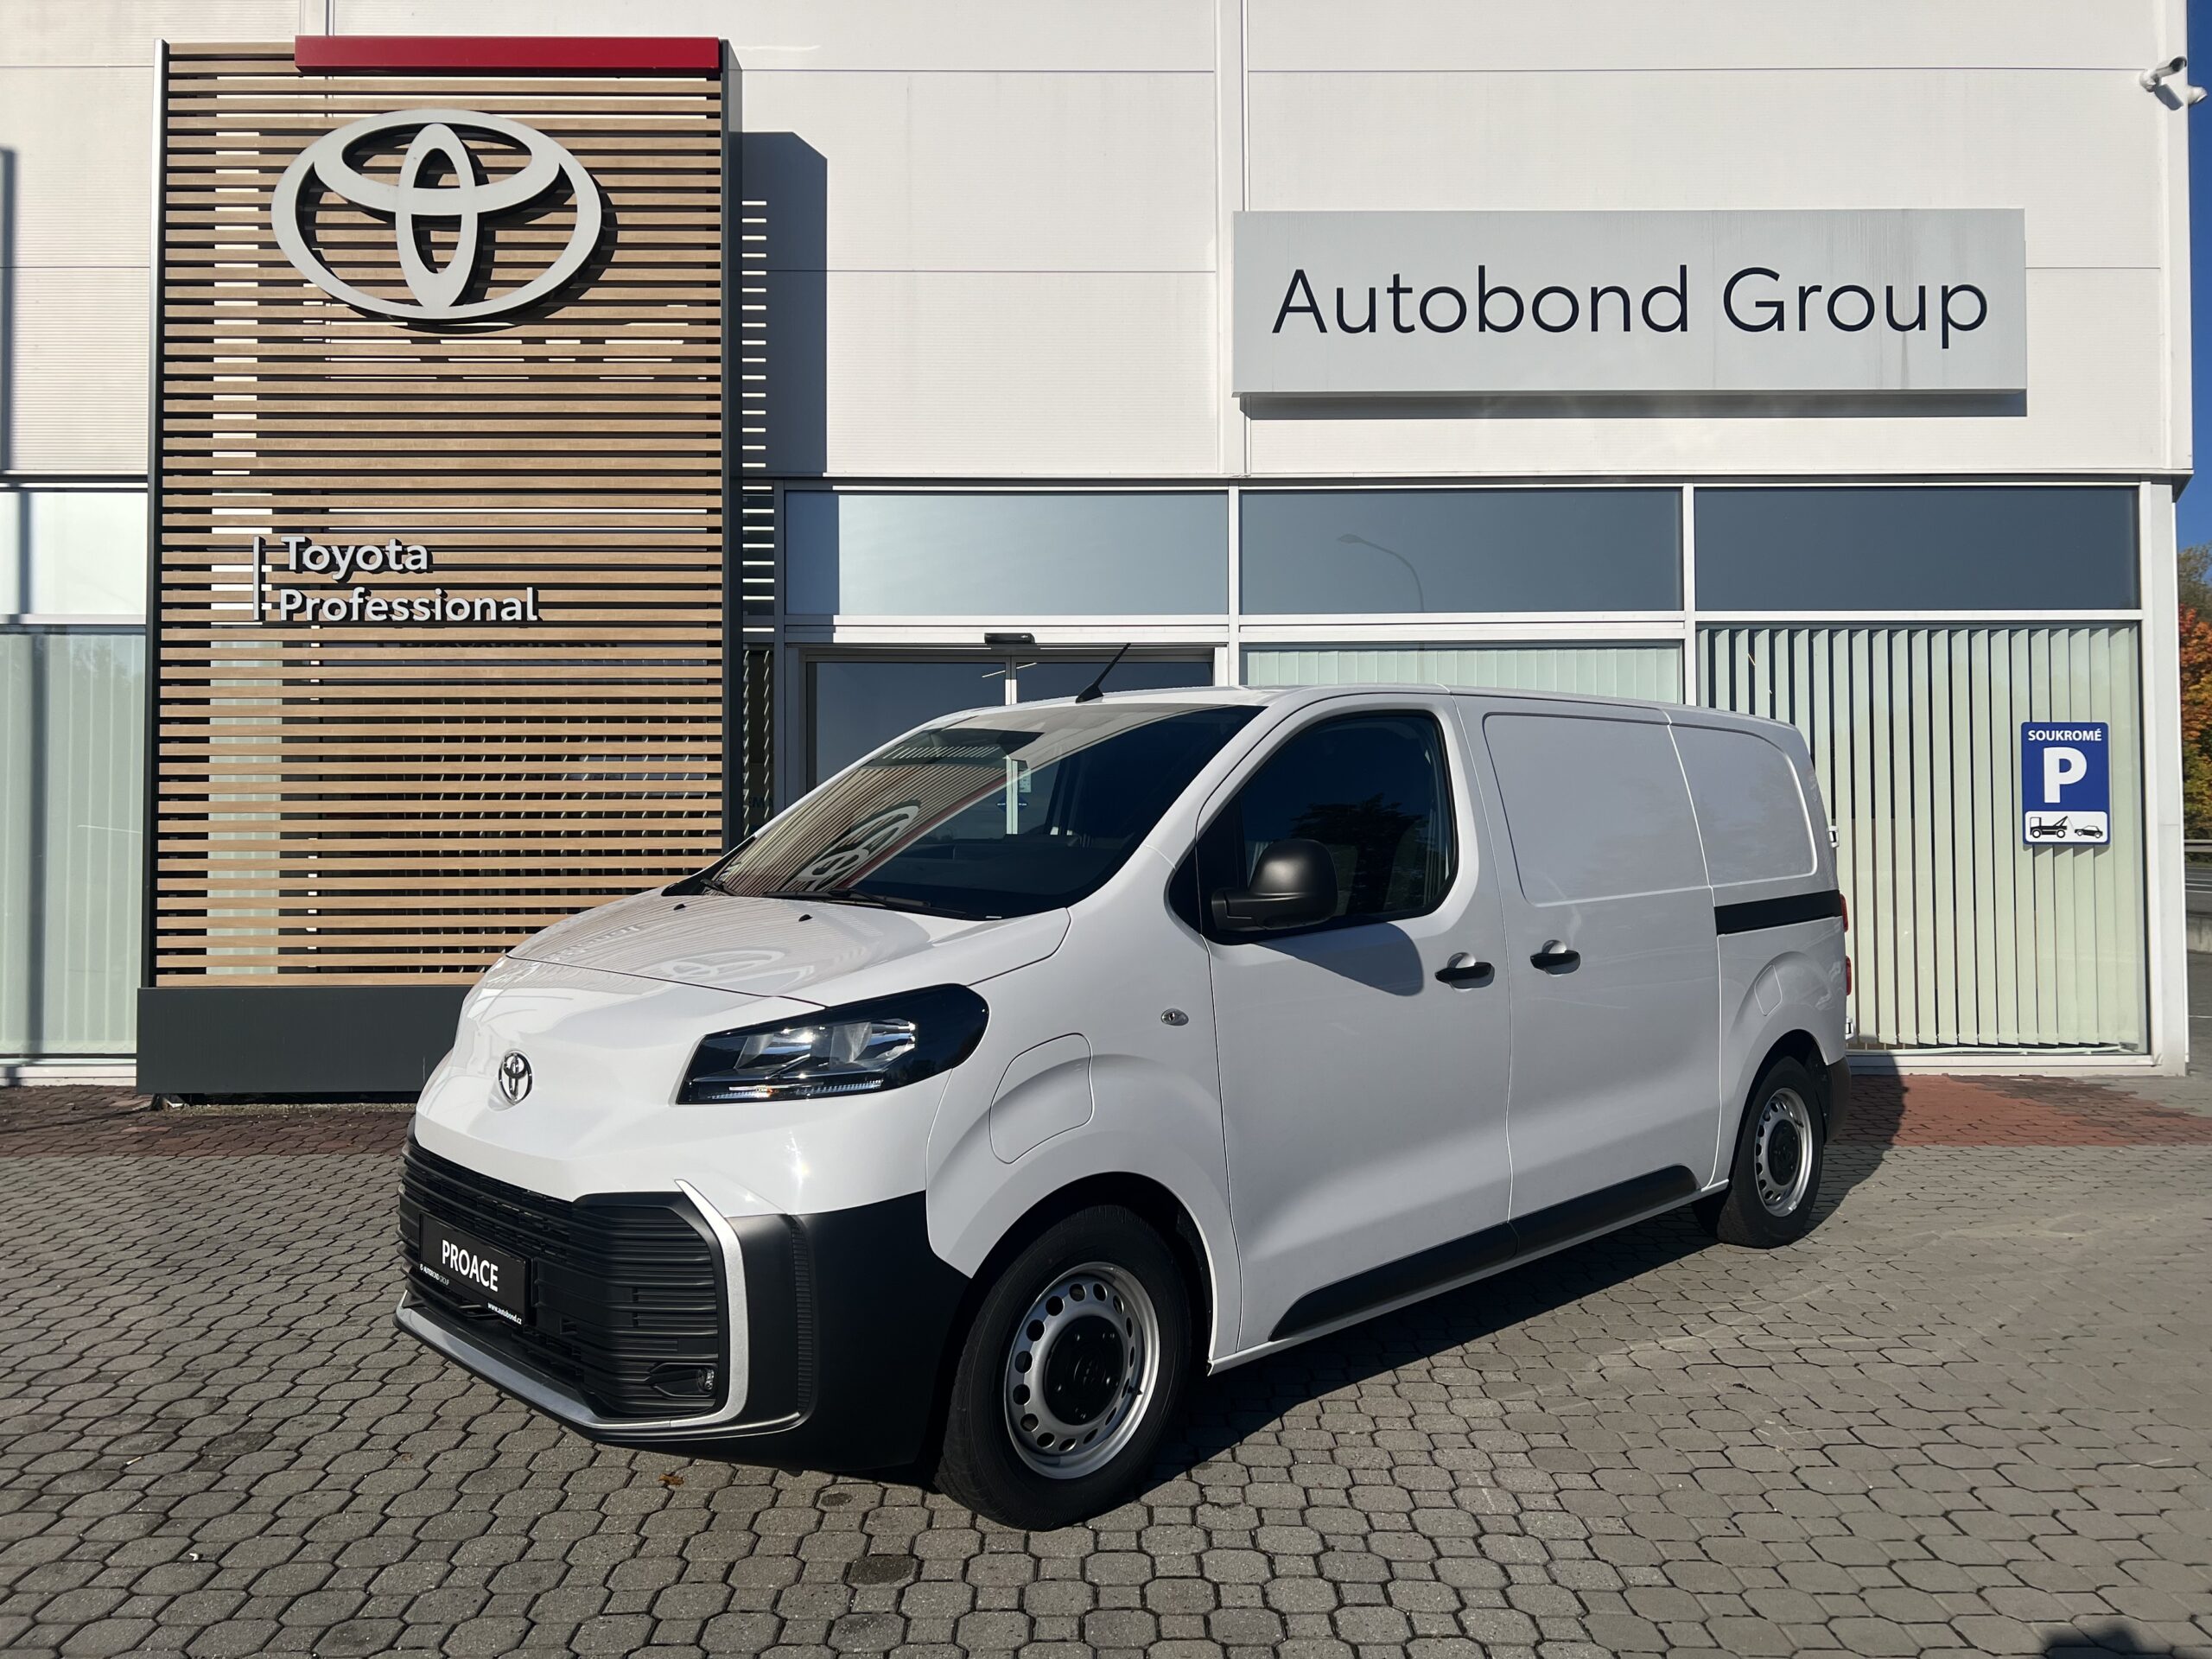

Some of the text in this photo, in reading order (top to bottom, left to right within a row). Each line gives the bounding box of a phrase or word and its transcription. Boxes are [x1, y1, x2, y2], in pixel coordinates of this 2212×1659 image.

[1271, 264, 1987, 350] Autobond Group
[280, 535, 429, 581] Toyota
[279, 586, 539, 621] Professional
[2028, 728, 2102, 741] SOUKROMÉ
[2043, 747, 2088, 804] P
[442, 1239, 499, 1293] PROACE
[487, 1301, 522, 1325] www.autobond.cz
